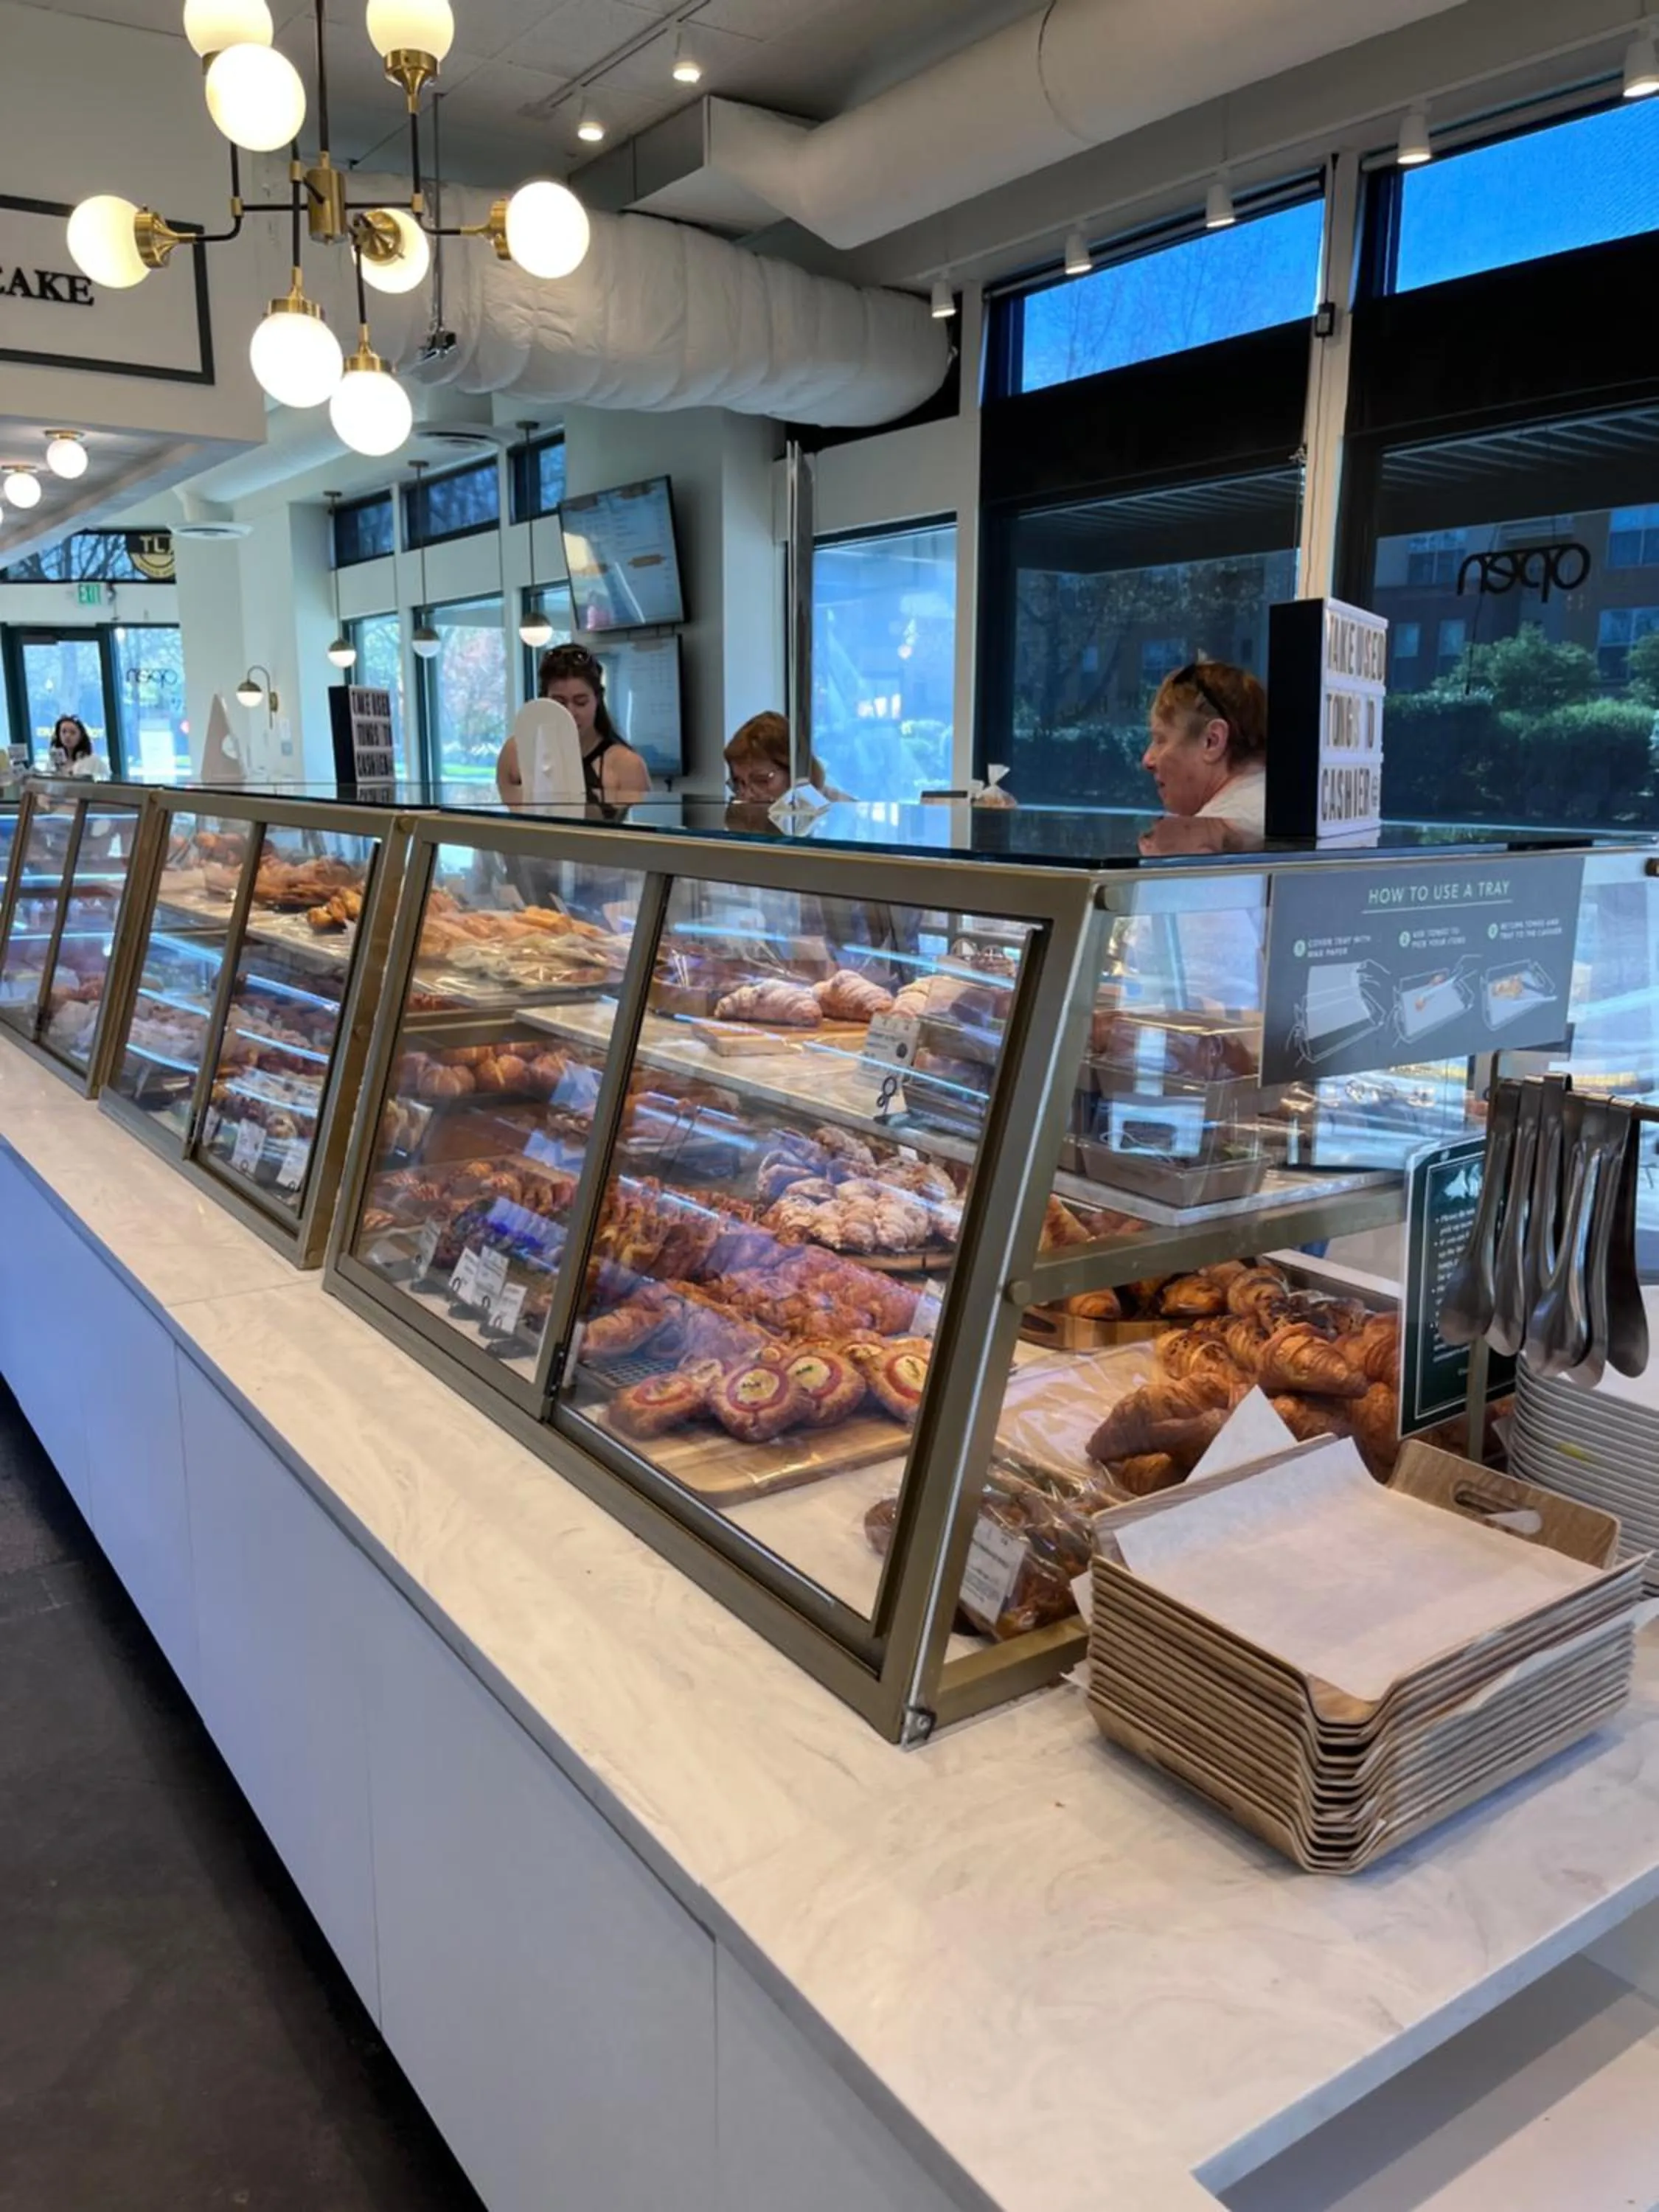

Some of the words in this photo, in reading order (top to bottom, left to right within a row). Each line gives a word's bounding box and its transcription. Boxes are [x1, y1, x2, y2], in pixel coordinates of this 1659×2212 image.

[0, 266, 94, 307] AKE
[1321, 767, 1370, 821] CASHIER
[1368, 887, 1404, 904] HOW
[1409, 886, 1429, 902] TO
[1433, 884, 1459, 900] USE
[1463, 883, 1473, 897] A
[1478, 880, 1511, 897] TRAY
